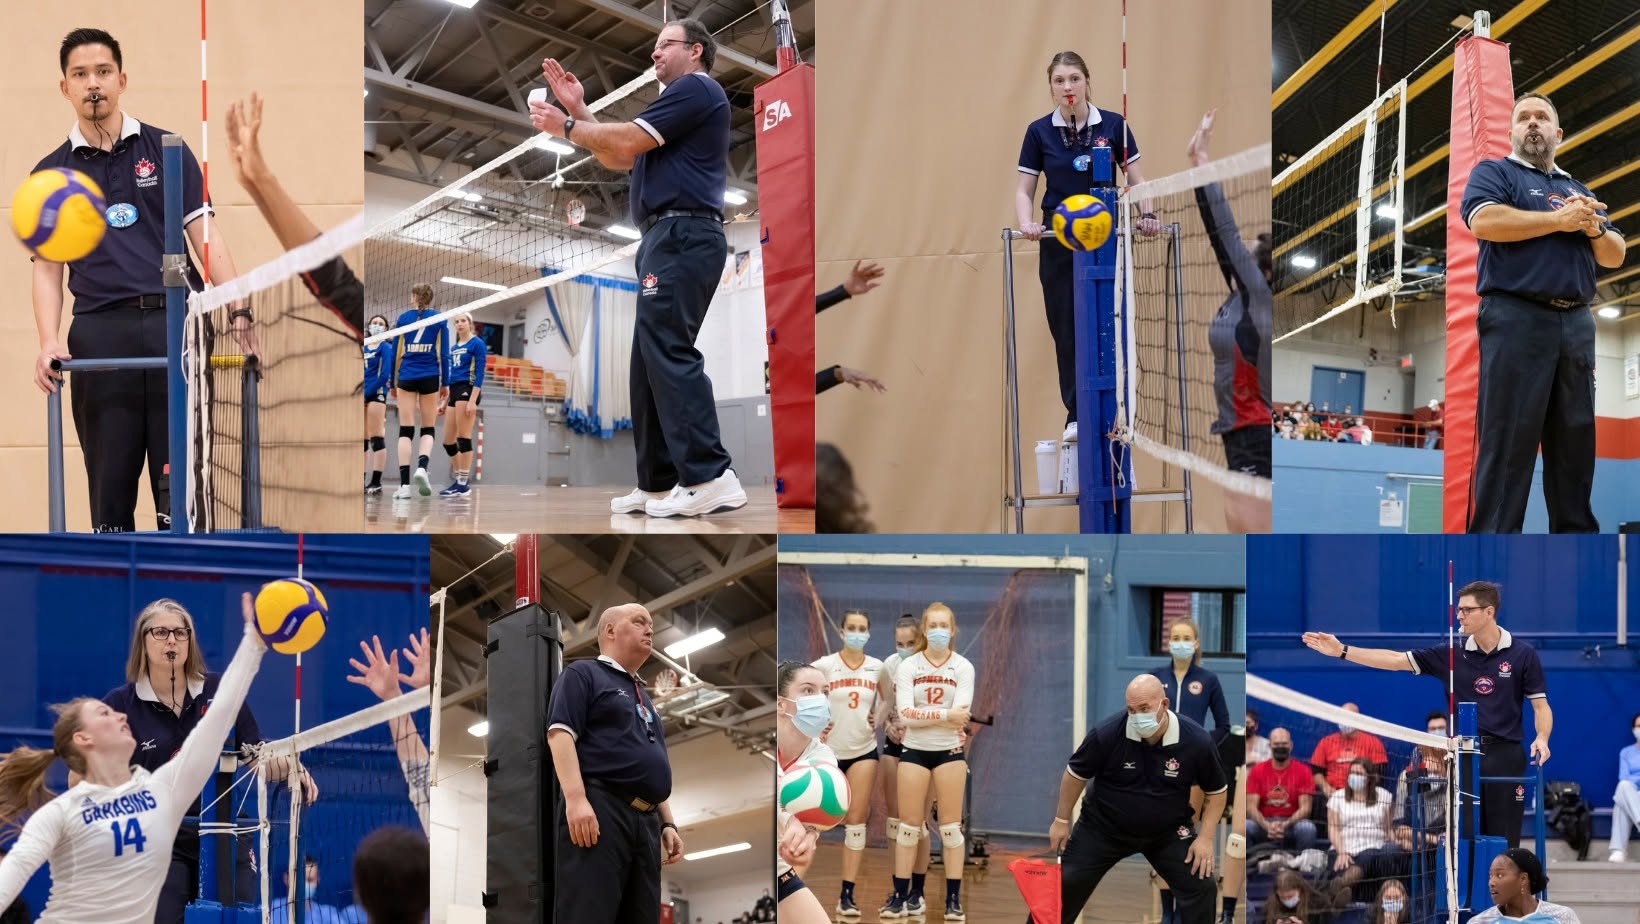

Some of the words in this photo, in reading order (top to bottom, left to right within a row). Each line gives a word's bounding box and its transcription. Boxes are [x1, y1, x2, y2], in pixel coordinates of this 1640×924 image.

[829, 678, 876, 691] BOOMERAN
[912, 675, 958, 689] BOOMERAN
[848, 691, 860, 709] 3
[924, 687, 945, 706] 12
[82, 789, 157, 825] CARABINS
[110, 817, 147, 858] 14
